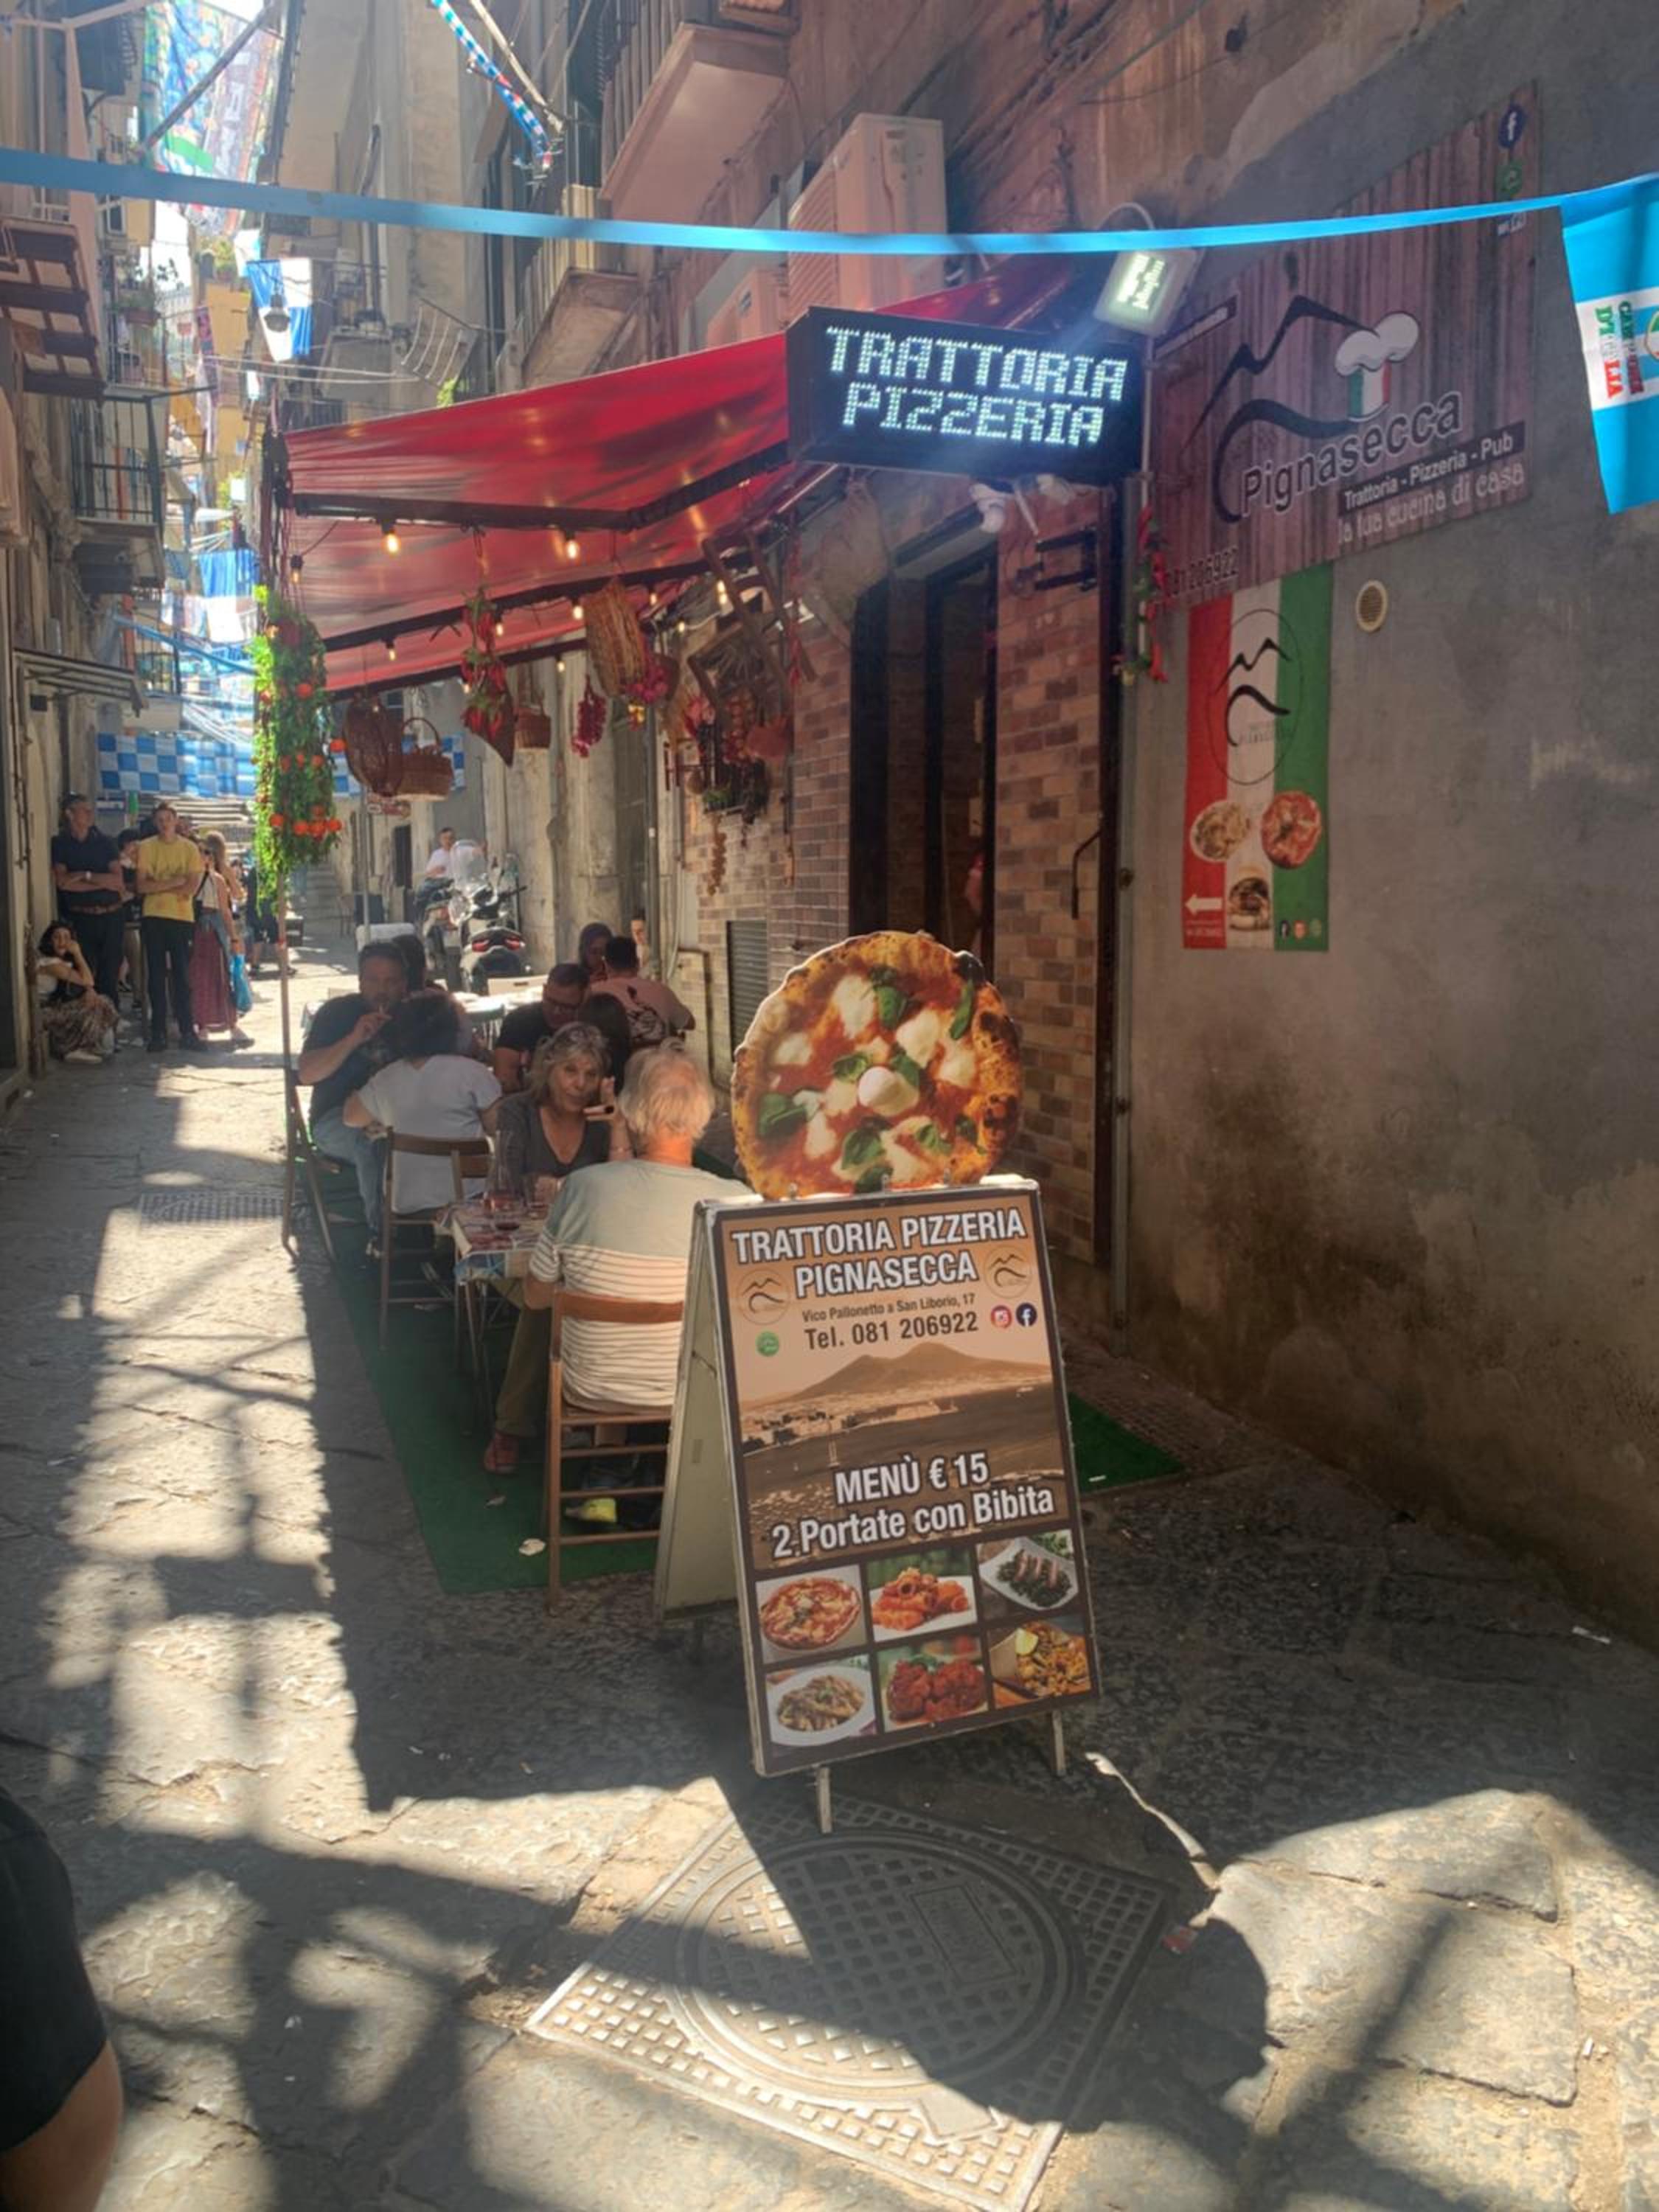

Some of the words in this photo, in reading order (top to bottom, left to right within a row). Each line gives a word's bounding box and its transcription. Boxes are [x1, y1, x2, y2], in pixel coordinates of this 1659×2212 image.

[827, 326, 1127, 401] TRATTORIA
[843, 381, 1104, 446] PIZZERIA
[1241, 391, 1463, 516] Pignasecca
[1344, 474, 1399, 510] Trattoria
[1410, 451, 1468, 485] Pizzeria
[1481, 434, 1514, 460] Pub
[1338, 518, 1352, 544] la
[1387, 490, 1447, 528] cucina
[1452, 474, 1470, 505] di
[1476, 462, 1526, 498] casa
[731, 1219, 895, 1263] TRATTORIA
[900, 1208, 1026, 1248] PIZZERIA
[795, 1251, 978, 1299] PIGNASECCA
[802, 1310, 827, 1322] Vico
[887, 1305, 894, 1313] a
[897, 1300, 917, 1312] San
[921, 1295, 961, 1309] Liborio,
[963, 1293, 975, 1304] 17
[804, 1326, 844, 1349] Tel.
[852, 1321, 888, 1344] 081
[900, 1312, 978, 1339] 206922
[835, 1455, 921, 1504] MENÙ
[929, 1458, 947, 1489] €
[953, 1453, 989, 1486] 15
[914, 1502, 965, 1534] con
[973, 1486, 1054, 1524] Bibita
